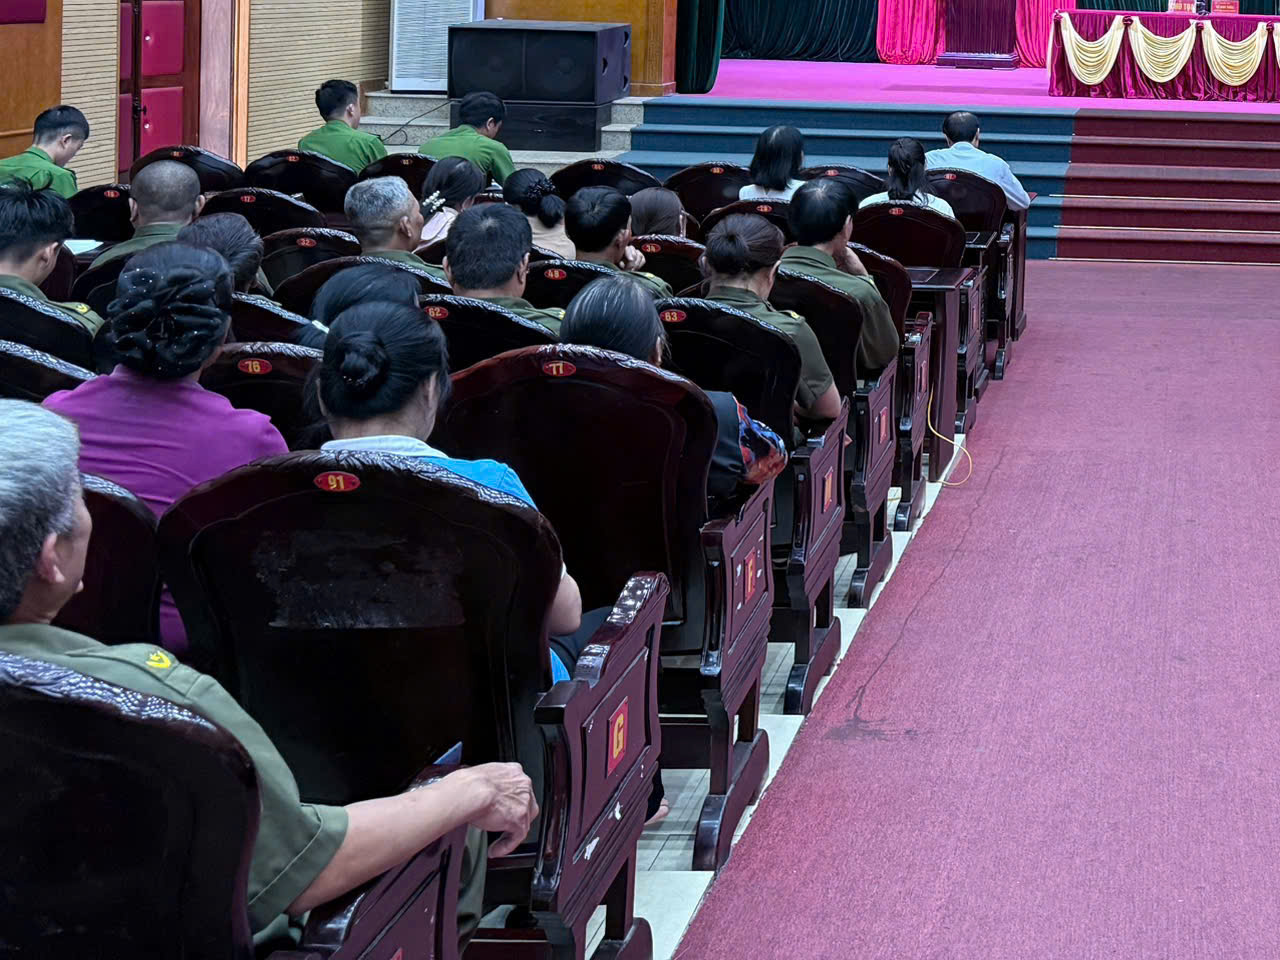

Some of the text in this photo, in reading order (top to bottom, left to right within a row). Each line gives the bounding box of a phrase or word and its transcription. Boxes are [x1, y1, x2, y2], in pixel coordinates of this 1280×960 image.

[428, 308, 442, 317] 62
[665, 312, 678, 320] 63
[549, 362, 564, 375] 77
[328, 475, 344, 490] 91
[613, 713, 624, 760] G
